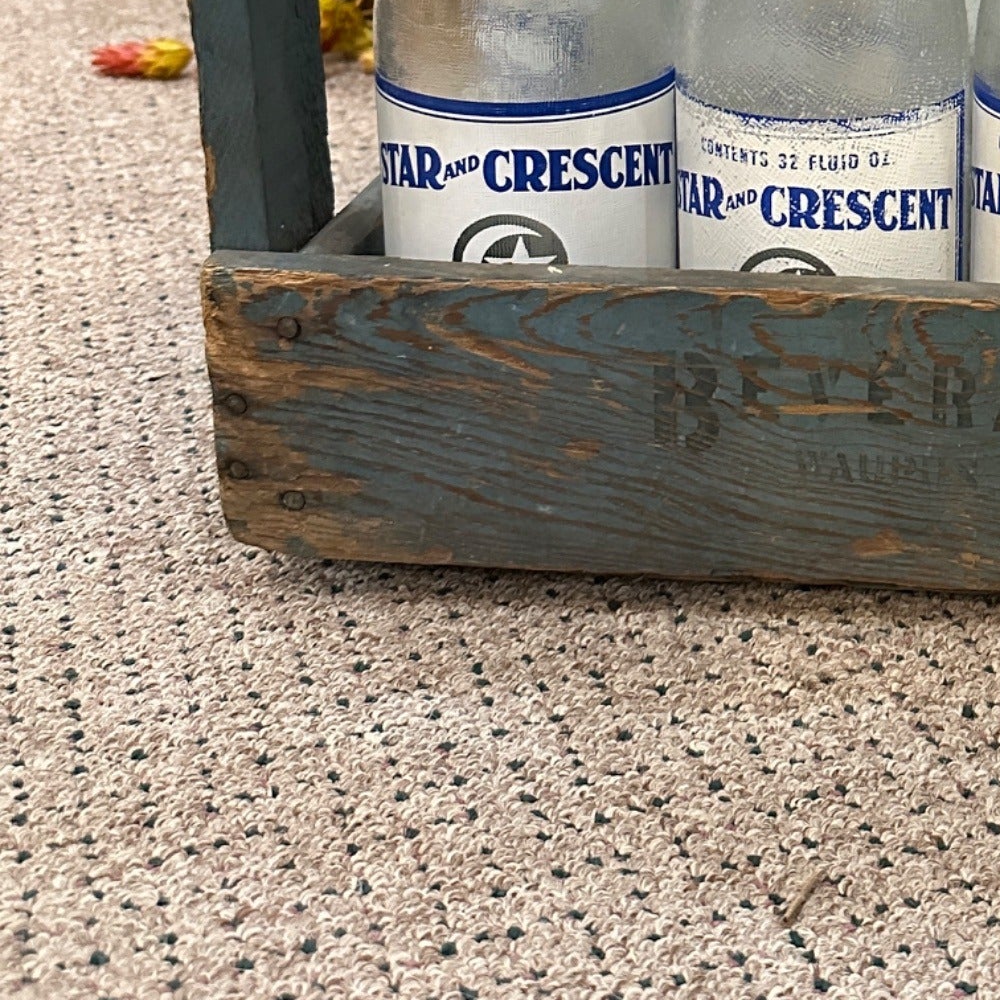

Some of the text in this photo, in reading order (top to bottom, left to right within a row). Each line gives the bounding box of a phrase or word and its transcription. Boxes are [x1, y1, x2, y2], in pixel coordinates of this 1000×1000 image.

[380, 141, 673, 192] STAR AND CRESCENT
[701, 136, 769, 168] CONTENTS
[778, 153, 798, 169] 32
[808, 154, 859, 172] FLUID
[677, 169, 953, 232] TAR AND CRESCENT
